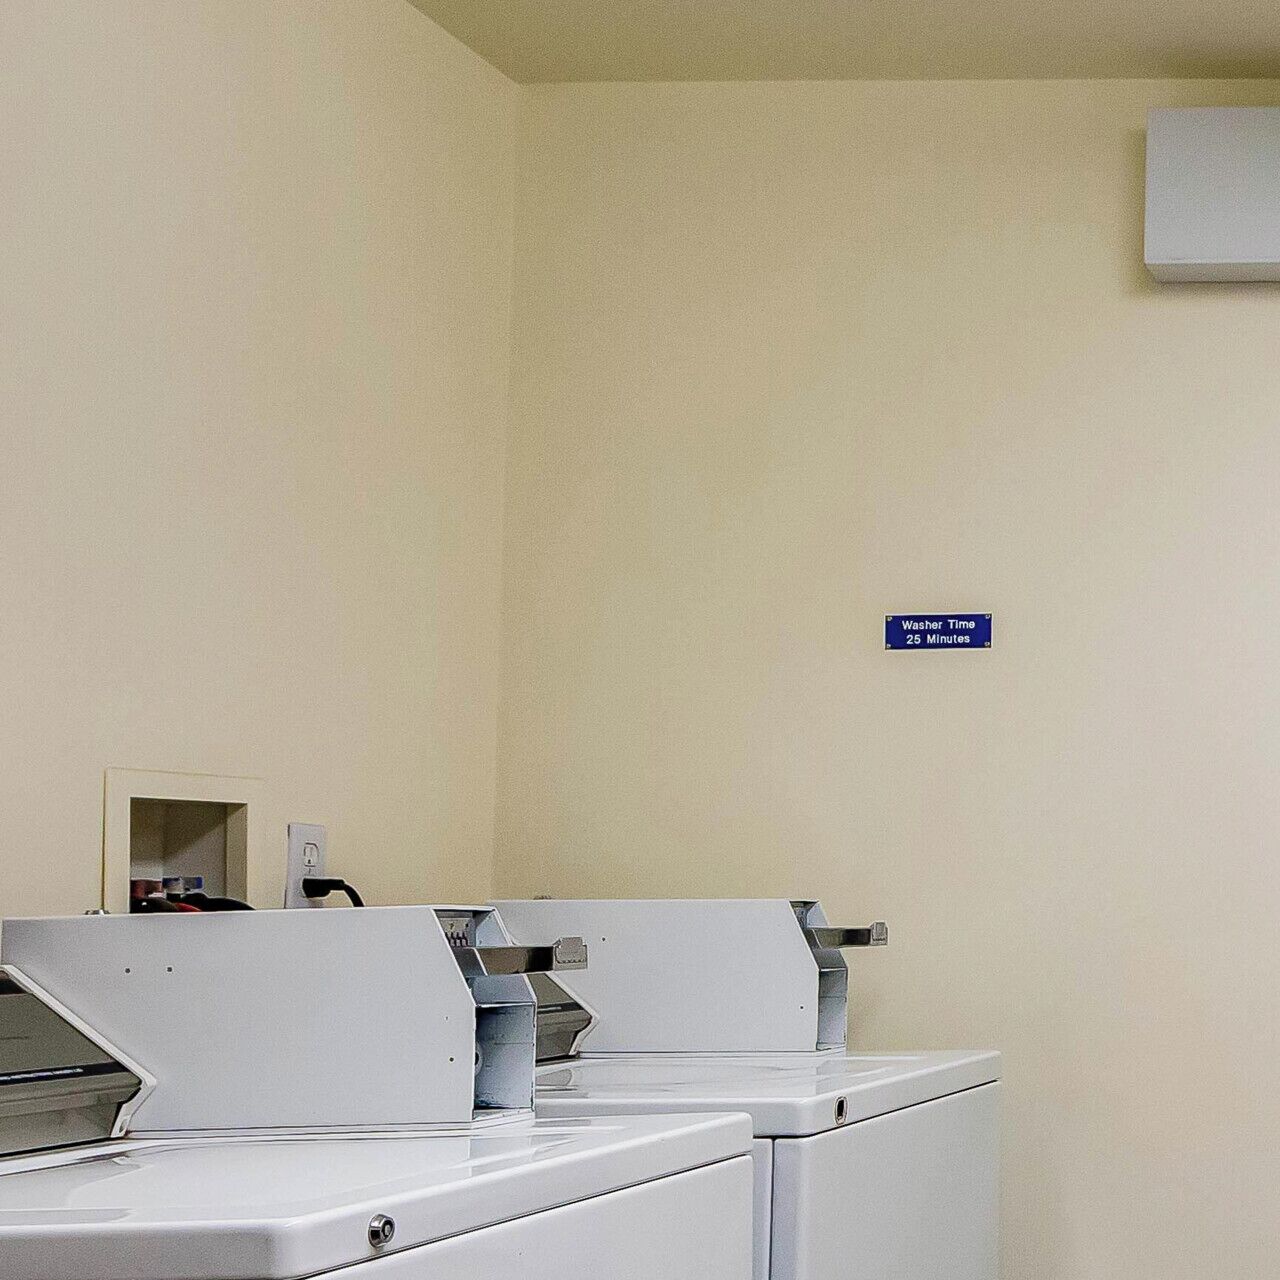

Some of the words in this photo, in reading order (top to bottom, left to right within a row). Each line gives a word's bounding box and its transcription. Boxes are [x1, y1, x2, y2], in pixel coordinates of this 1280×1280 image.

[901, 620, 943, 630] Washer
[948, 619, 976, 629] Time
[906, 634, 921, 644] 25
[926, 633, 970, 644] Minutes
